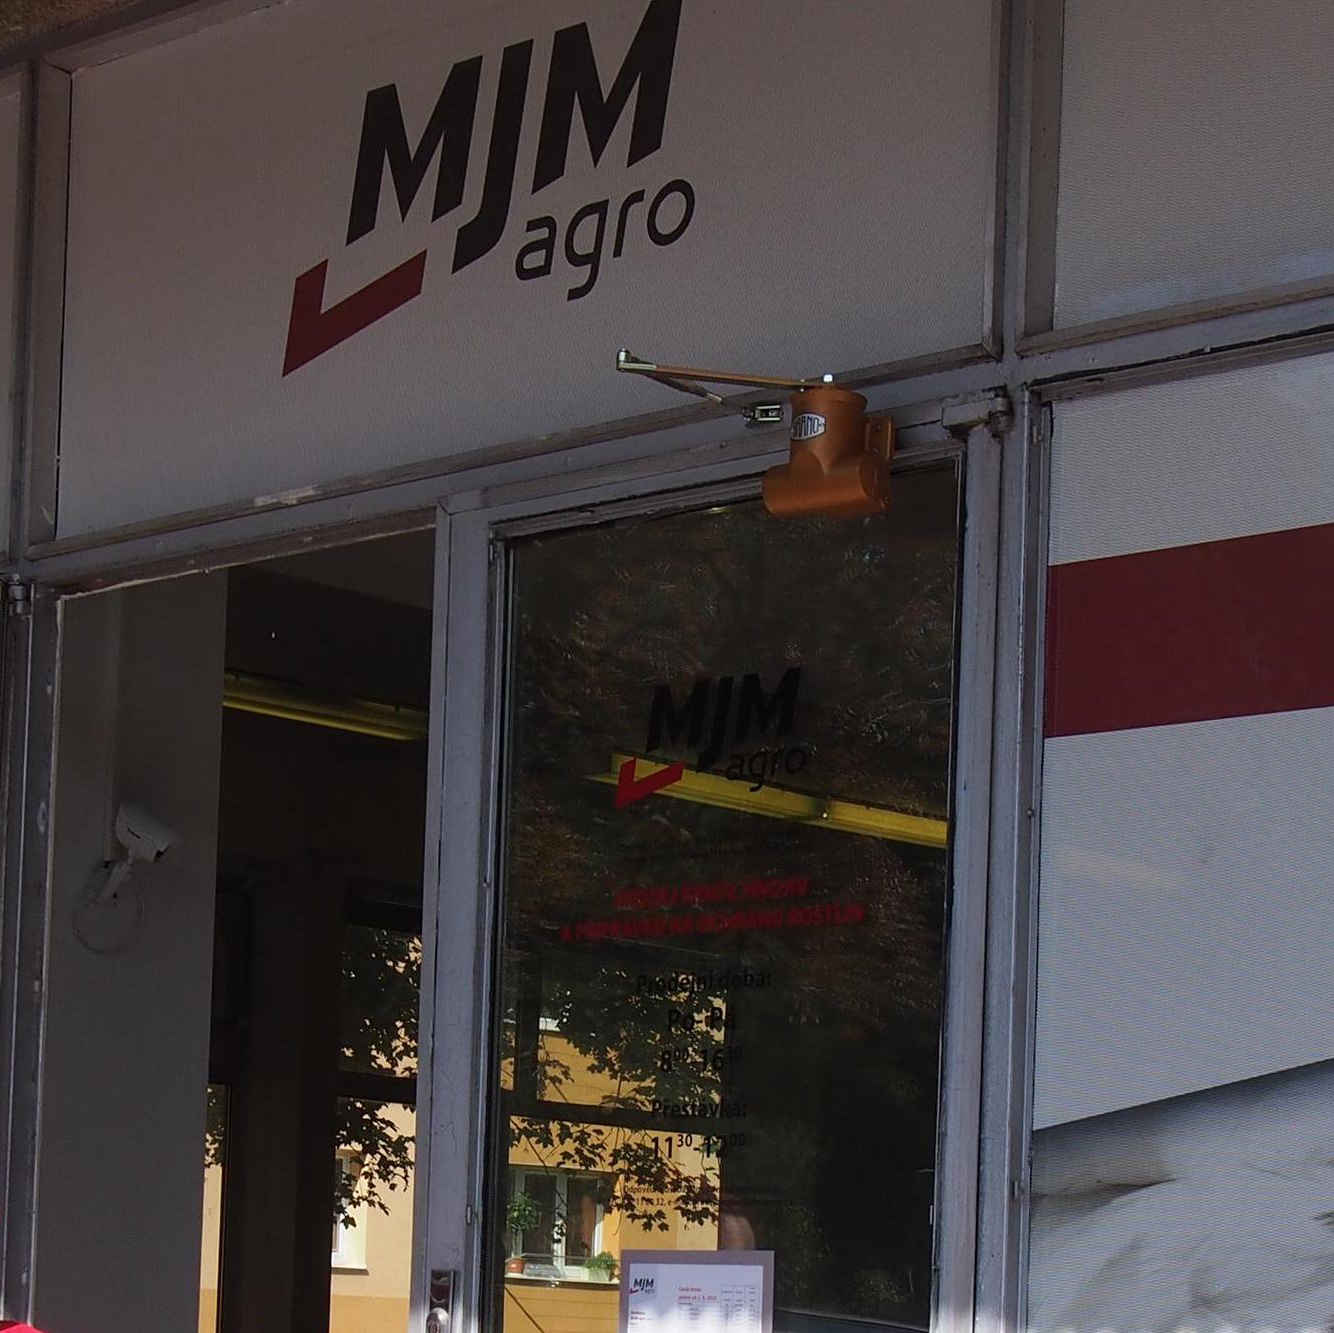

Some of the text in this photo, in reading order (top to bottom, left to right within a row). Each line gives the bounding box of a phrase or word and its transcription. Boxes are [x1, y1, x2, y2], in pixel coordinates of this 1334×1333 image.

[346, 0, 682, 275] MJM
[515, 178, 696, 301] agro
[645, 666, 802, 773] MJM
[726, 743, 807, 793] agro
[633, 1278, 655, 1291] MJM
